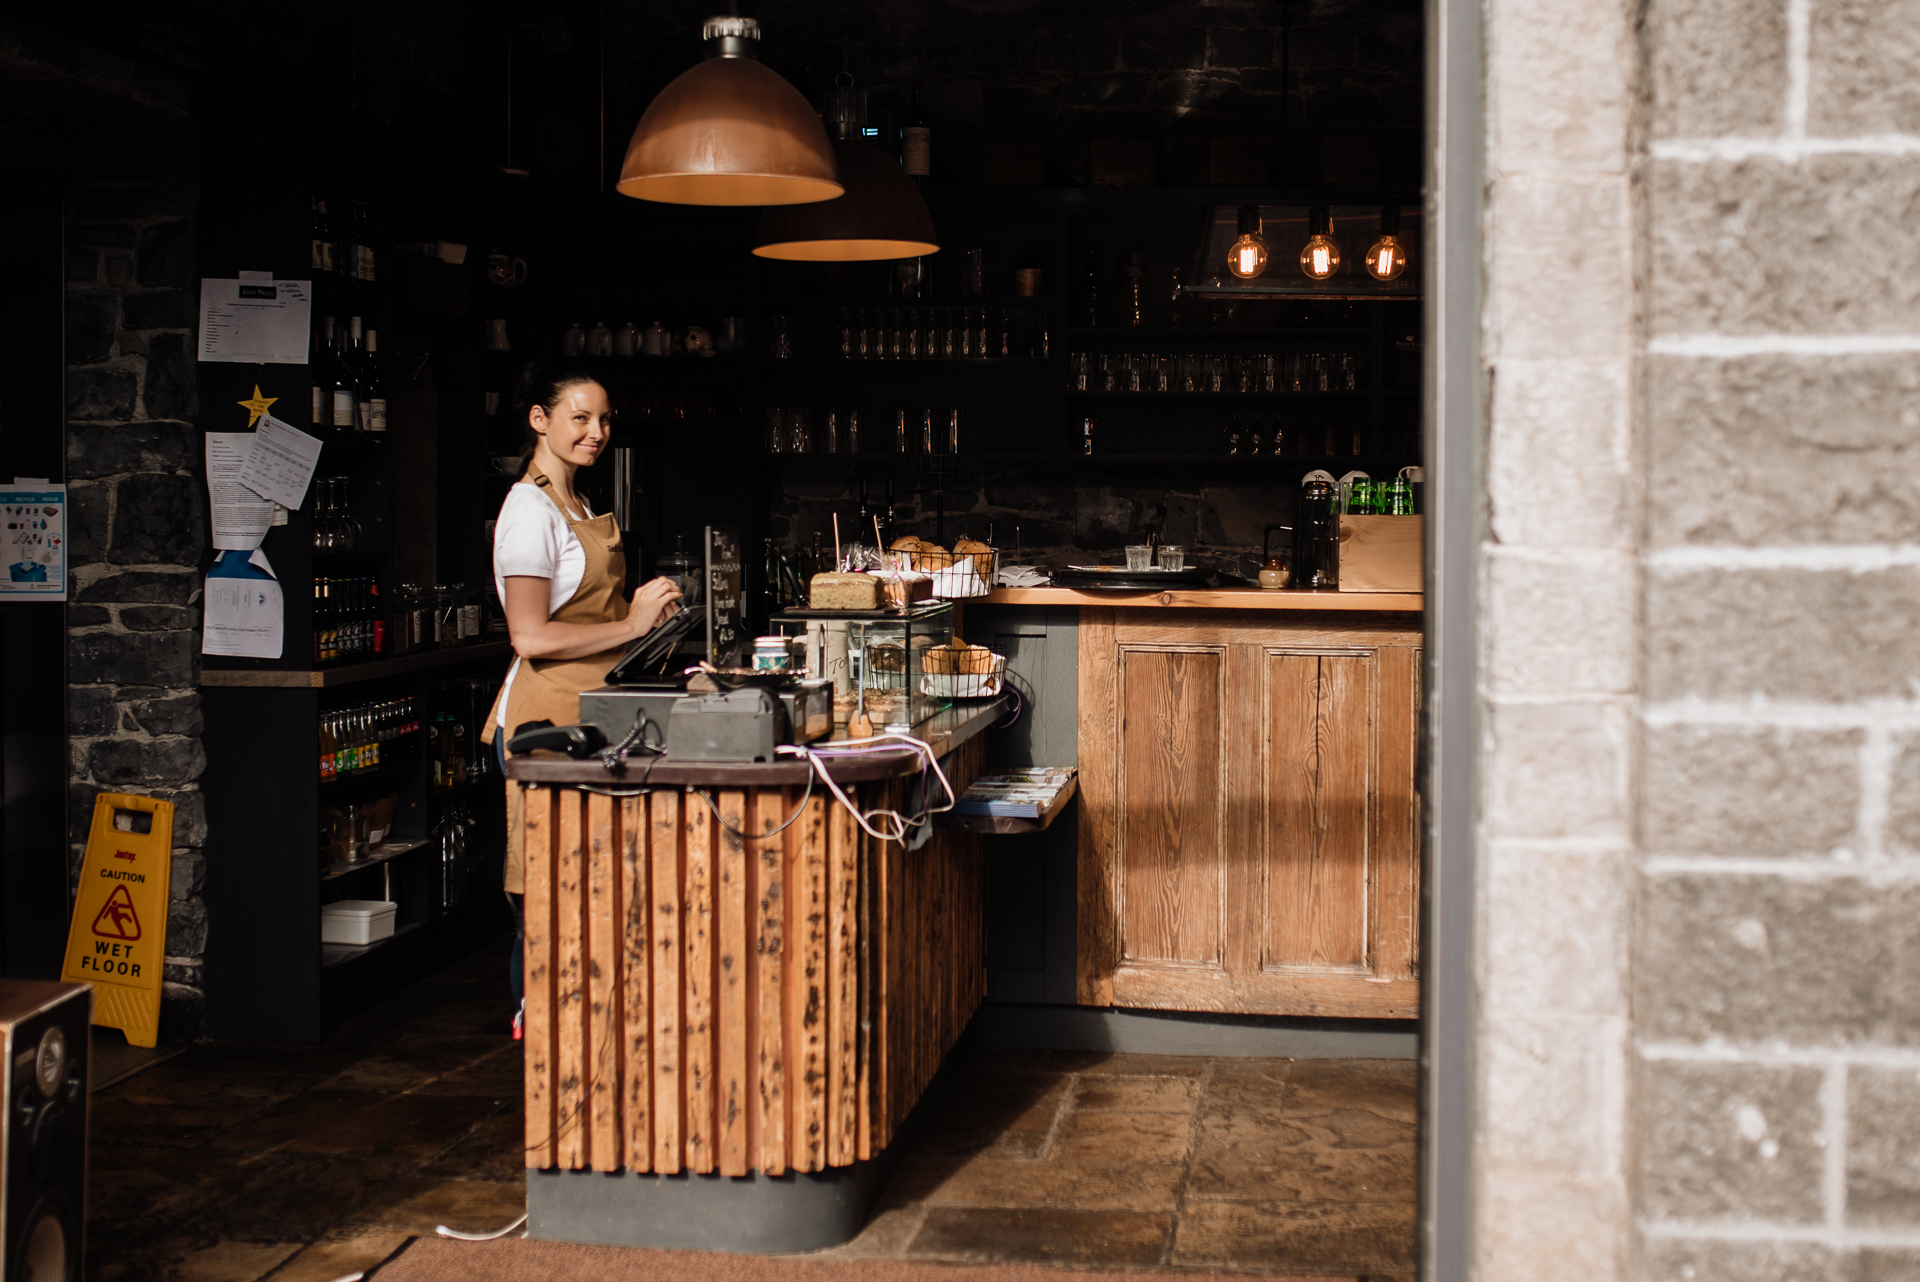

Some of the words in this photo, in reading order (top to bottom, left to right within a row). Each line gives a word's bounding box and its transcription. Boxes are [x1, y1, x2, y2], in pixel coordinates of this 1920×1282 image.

[100, 868, 145, 884] CAUTION
[95, 940, 133, 959] WET
[81, 956, 141, 977] FLOOR
